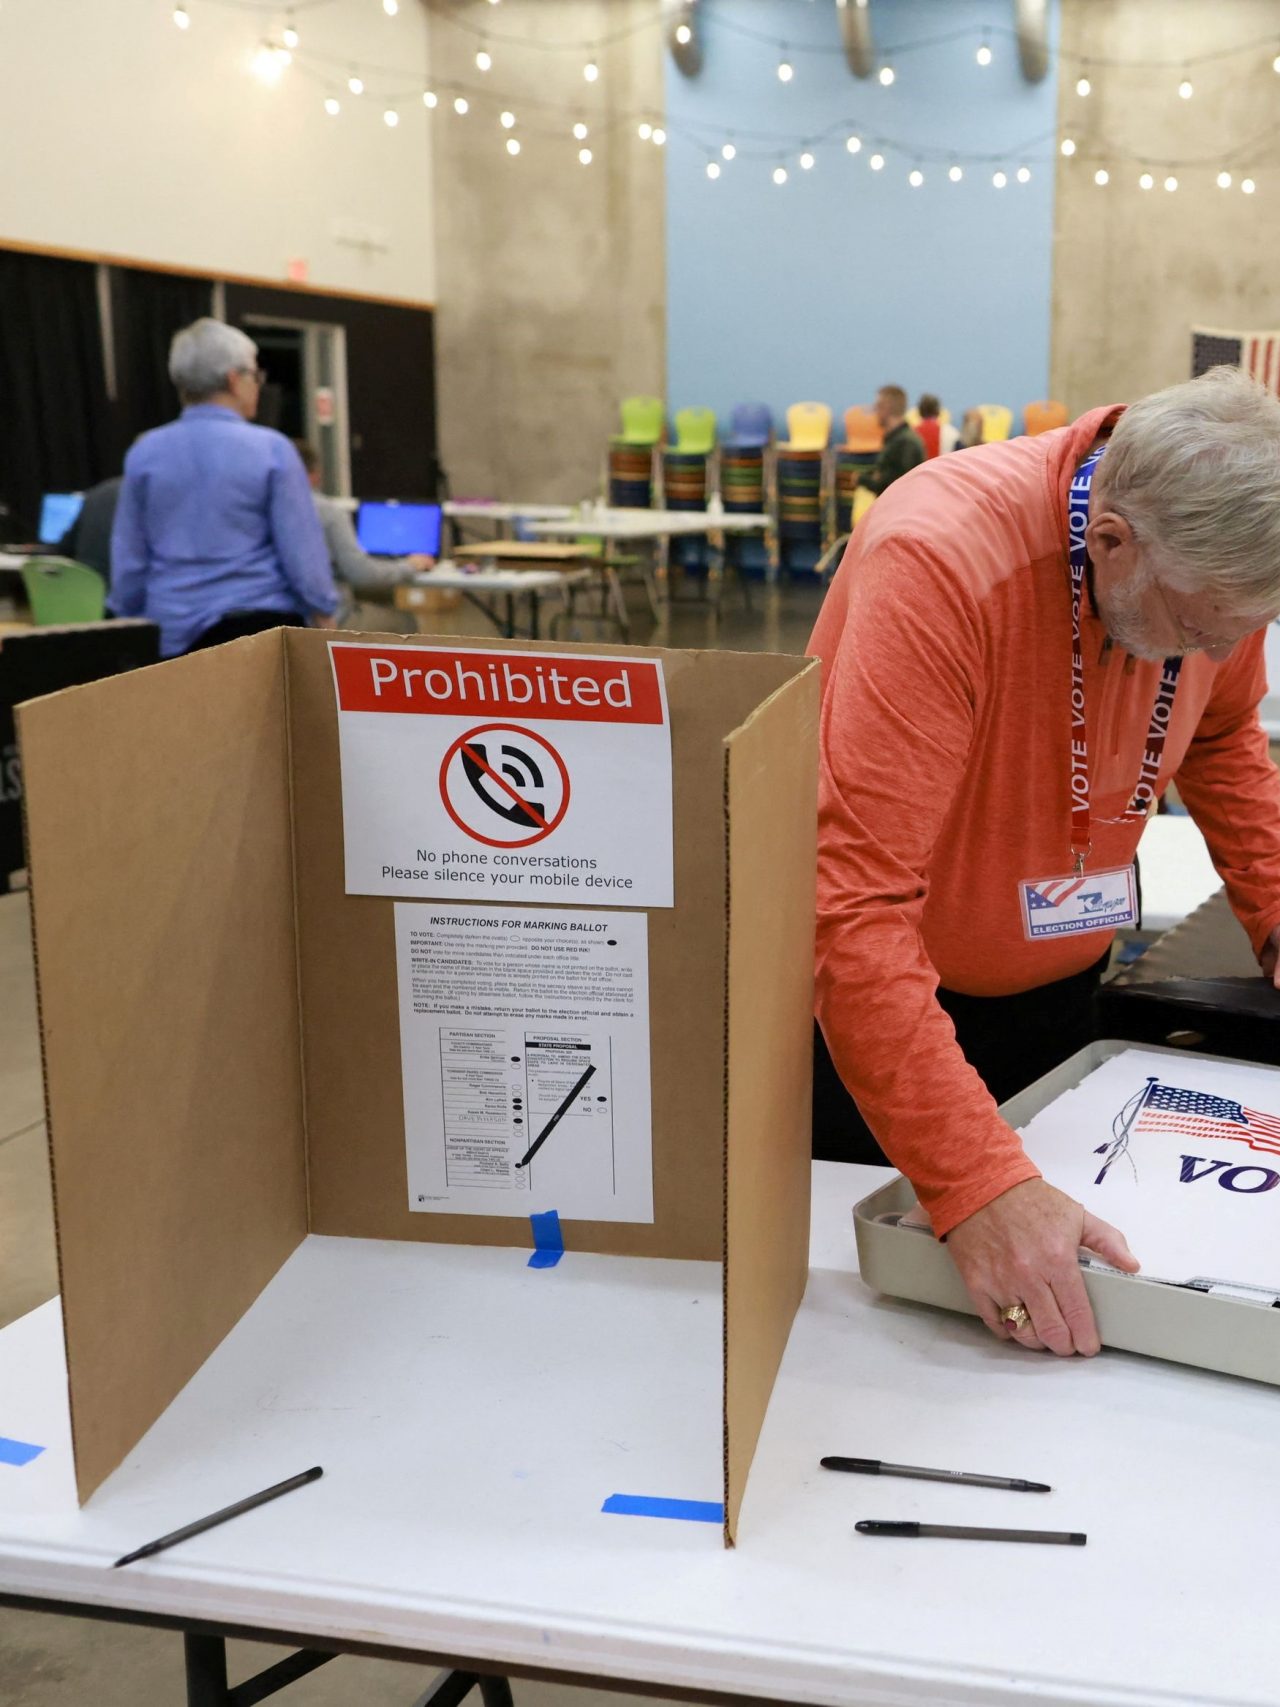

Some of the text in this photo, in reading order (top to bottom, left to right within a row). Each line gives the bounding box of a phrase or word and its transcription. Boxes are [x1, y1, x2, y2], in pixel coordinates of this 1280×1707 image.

[1069, 475, 1092, 552] VOTE
[1071, 564, 1084, 640] VOTE
[369, 658, 632, 708] Prohibited
[1072, 654, 1084, 727] VOTE
[1148, 668, 1181, 738] VOTE
[1072, 739, 1090, 812] VOTE
[381, 866, 633, 889] Please silence your mobile device
[416, 849, 597, 869] No phone conversations
[430, 917, 608, 932] INSTRUCTIONS FOR MARKING BALLOT
[1033, 914, 1131, 934] ELECTION OFFICIAL
